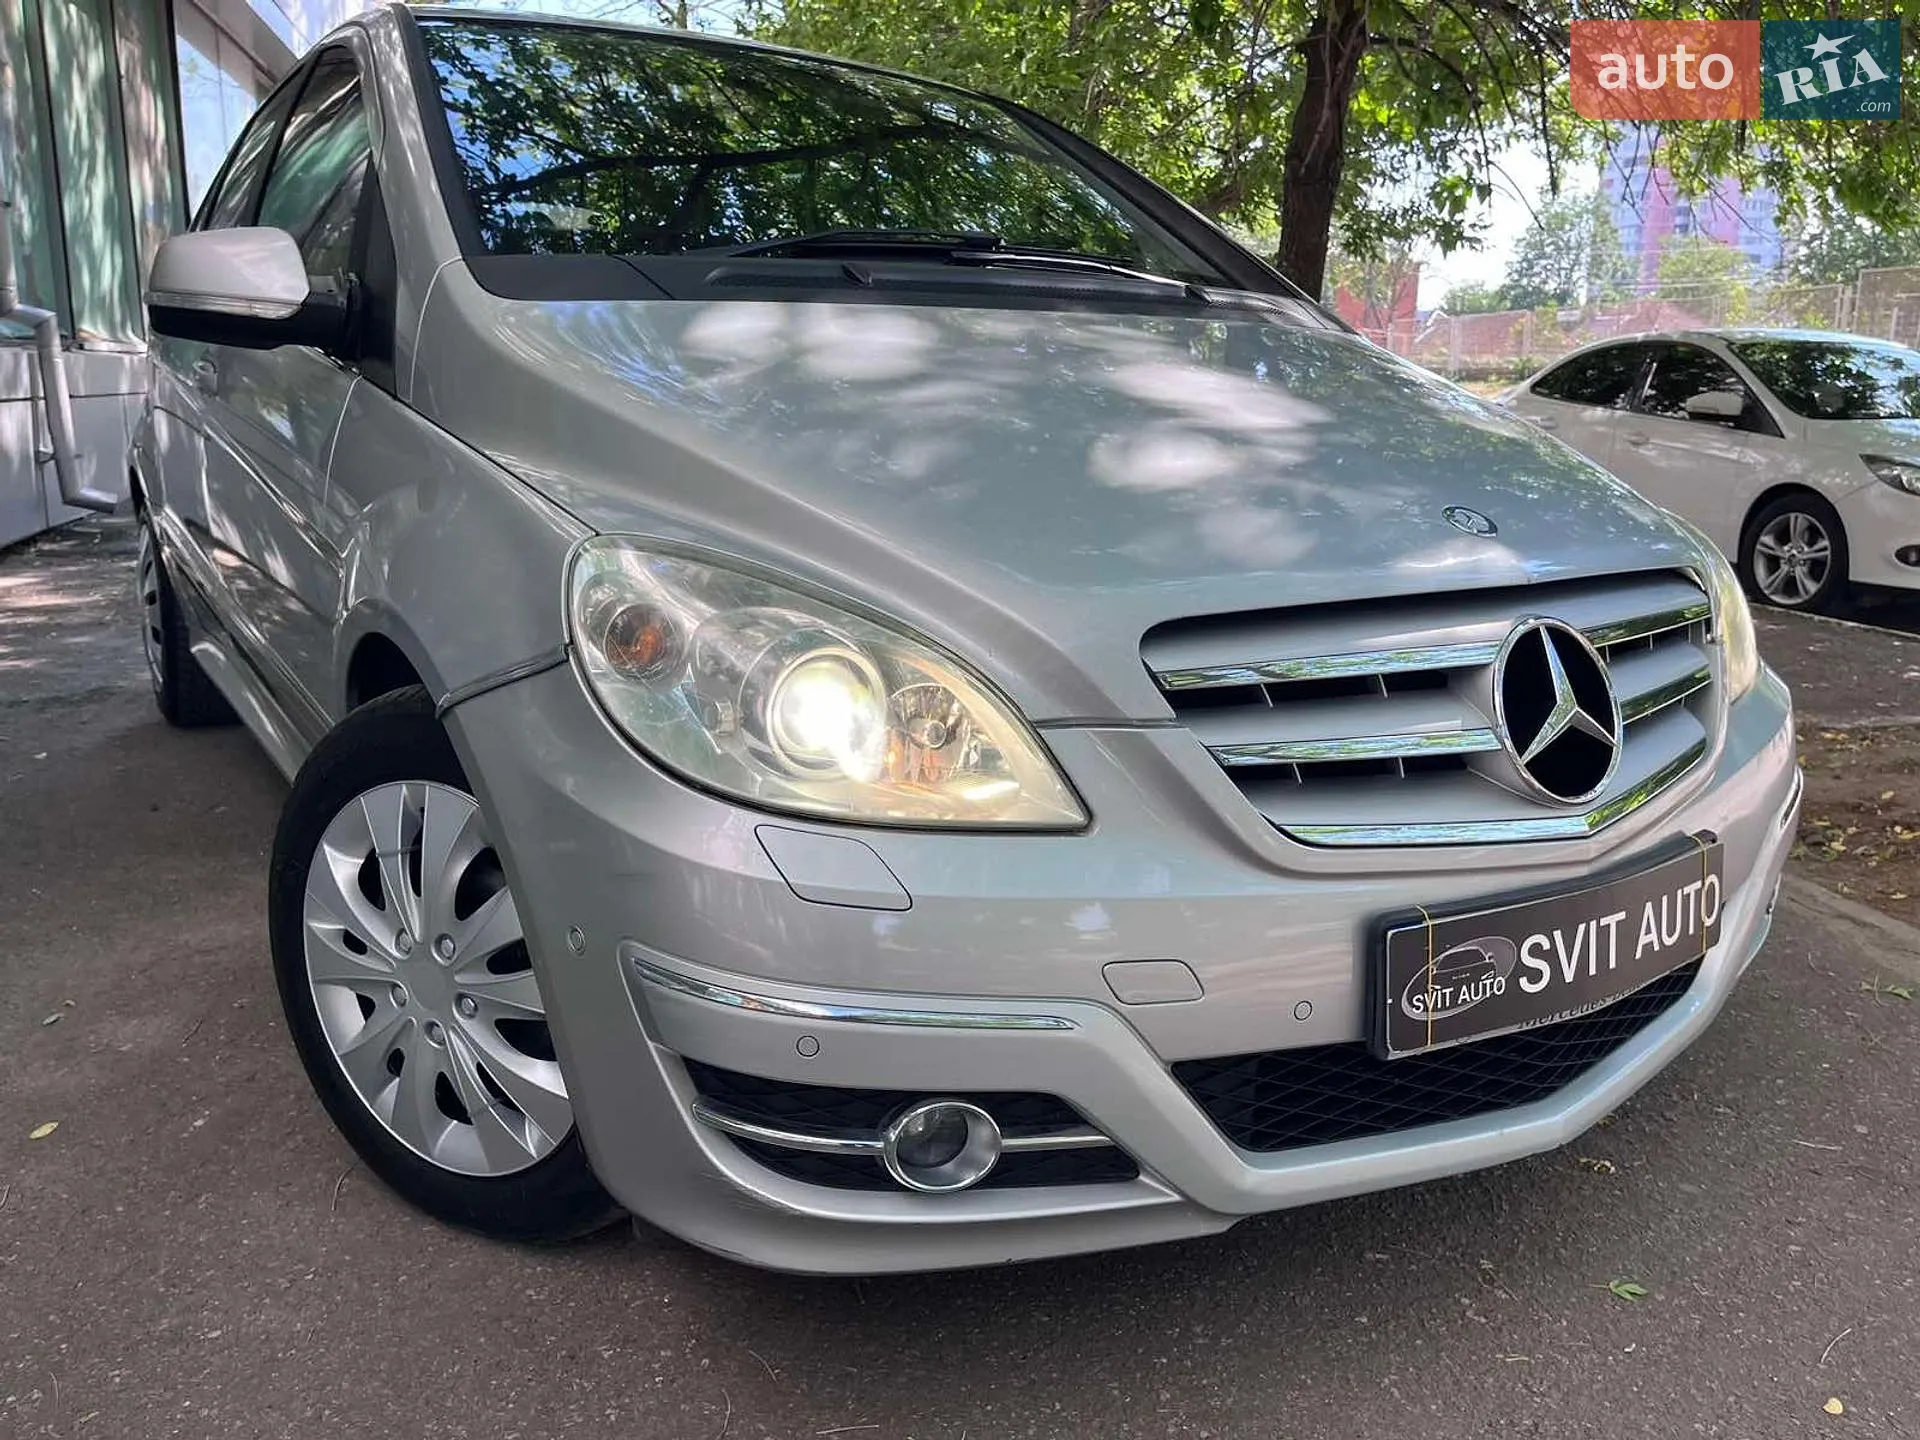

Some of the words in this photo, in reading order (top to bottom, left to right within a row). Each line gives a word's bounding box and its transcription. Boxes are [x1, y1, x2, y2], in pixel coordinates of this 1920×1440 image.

[1519, 911, 1626, 994] SVIT
[1635, 873, 1720, 960] AUTO
[1412, 986, 1453, 1013] SVIT
[1458, 976, 1505, 1004] AUTO
